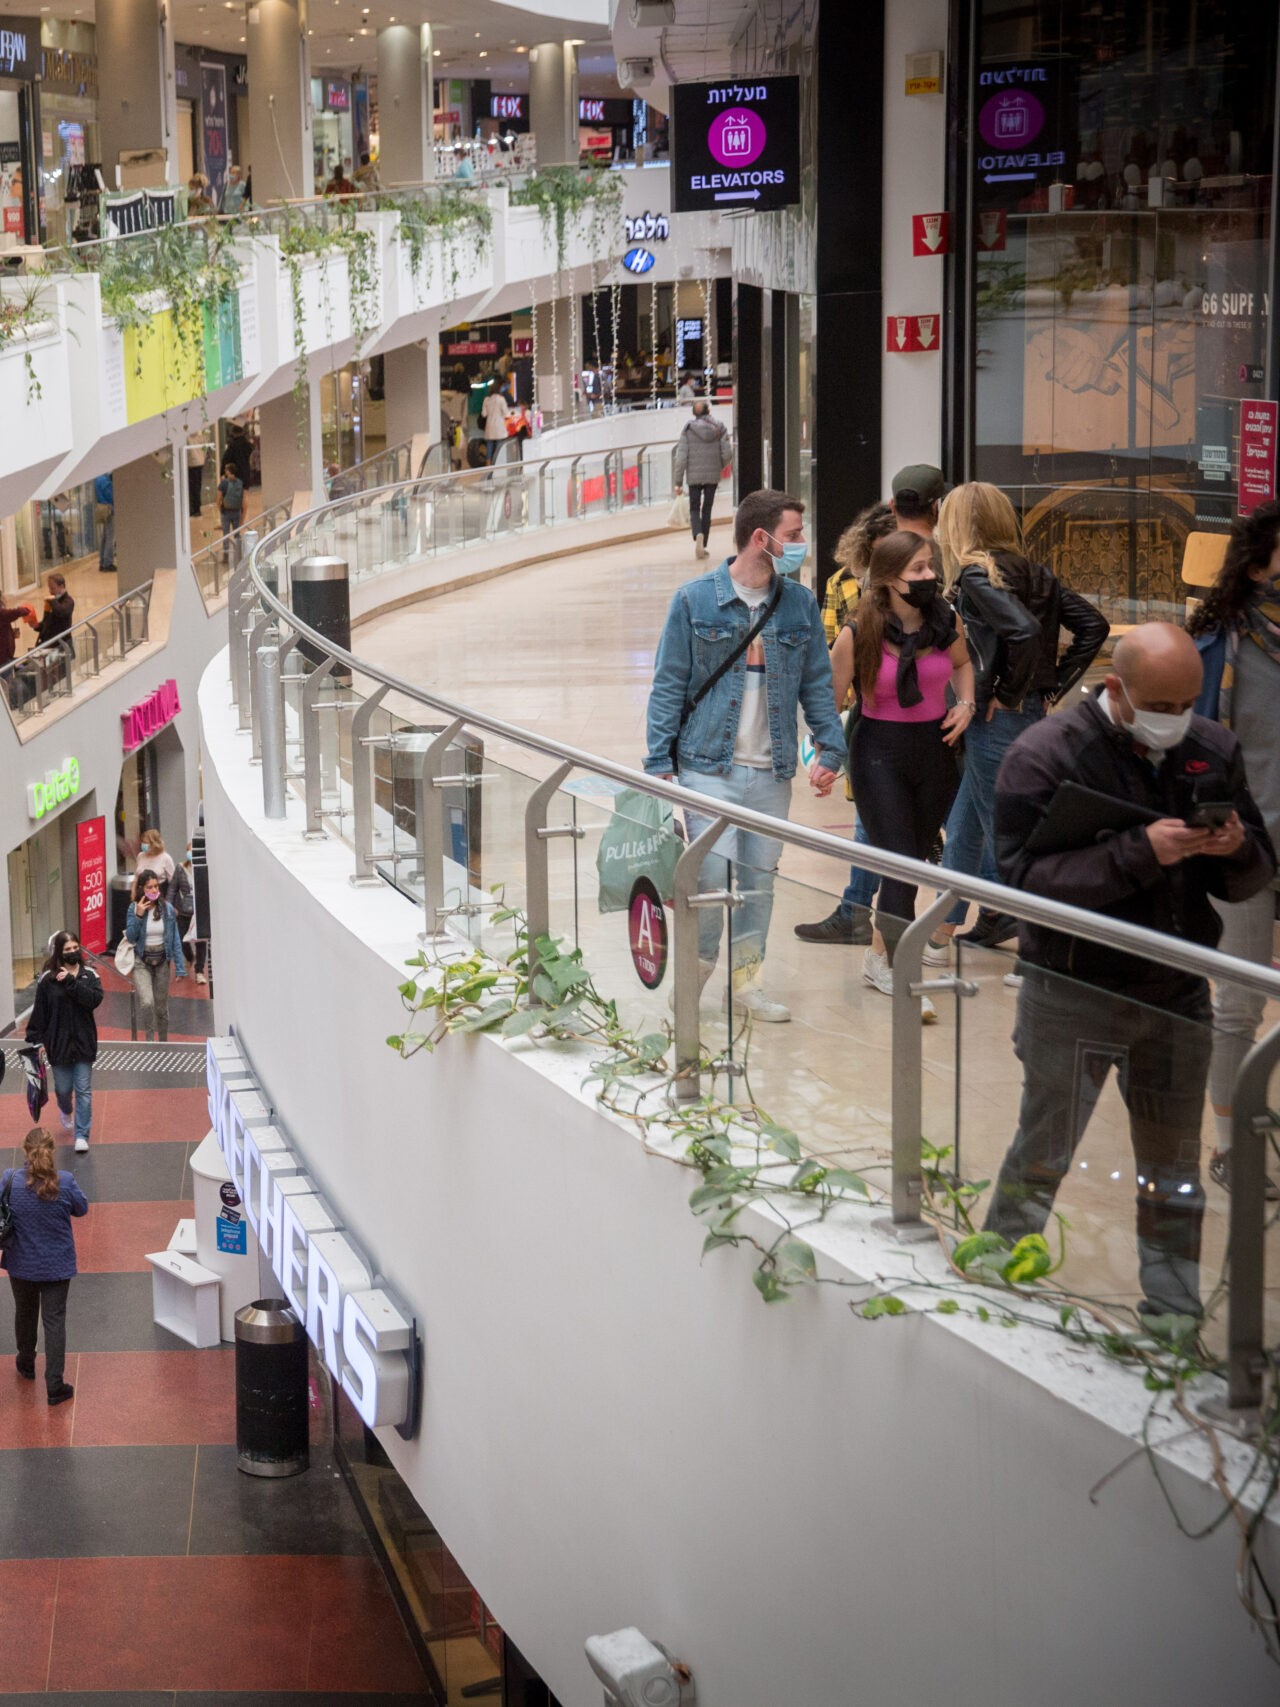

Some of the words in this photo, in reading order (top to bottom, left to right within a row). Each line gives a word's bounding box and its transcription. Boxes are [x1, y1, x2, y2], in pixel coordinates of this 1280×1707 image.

[707, 84, 768, 104] מעליות
[493, 96, 522, 117] FOX
[580, 100, 605, 120] FOX
[691, 170, 785, 190] ELEVATORS
[625, 211, 669, 241] הלפר
[1202, 293, 1218, 315] 66
[32, 770, 71, 819] Delta
[637, 900, 654, 956] A
